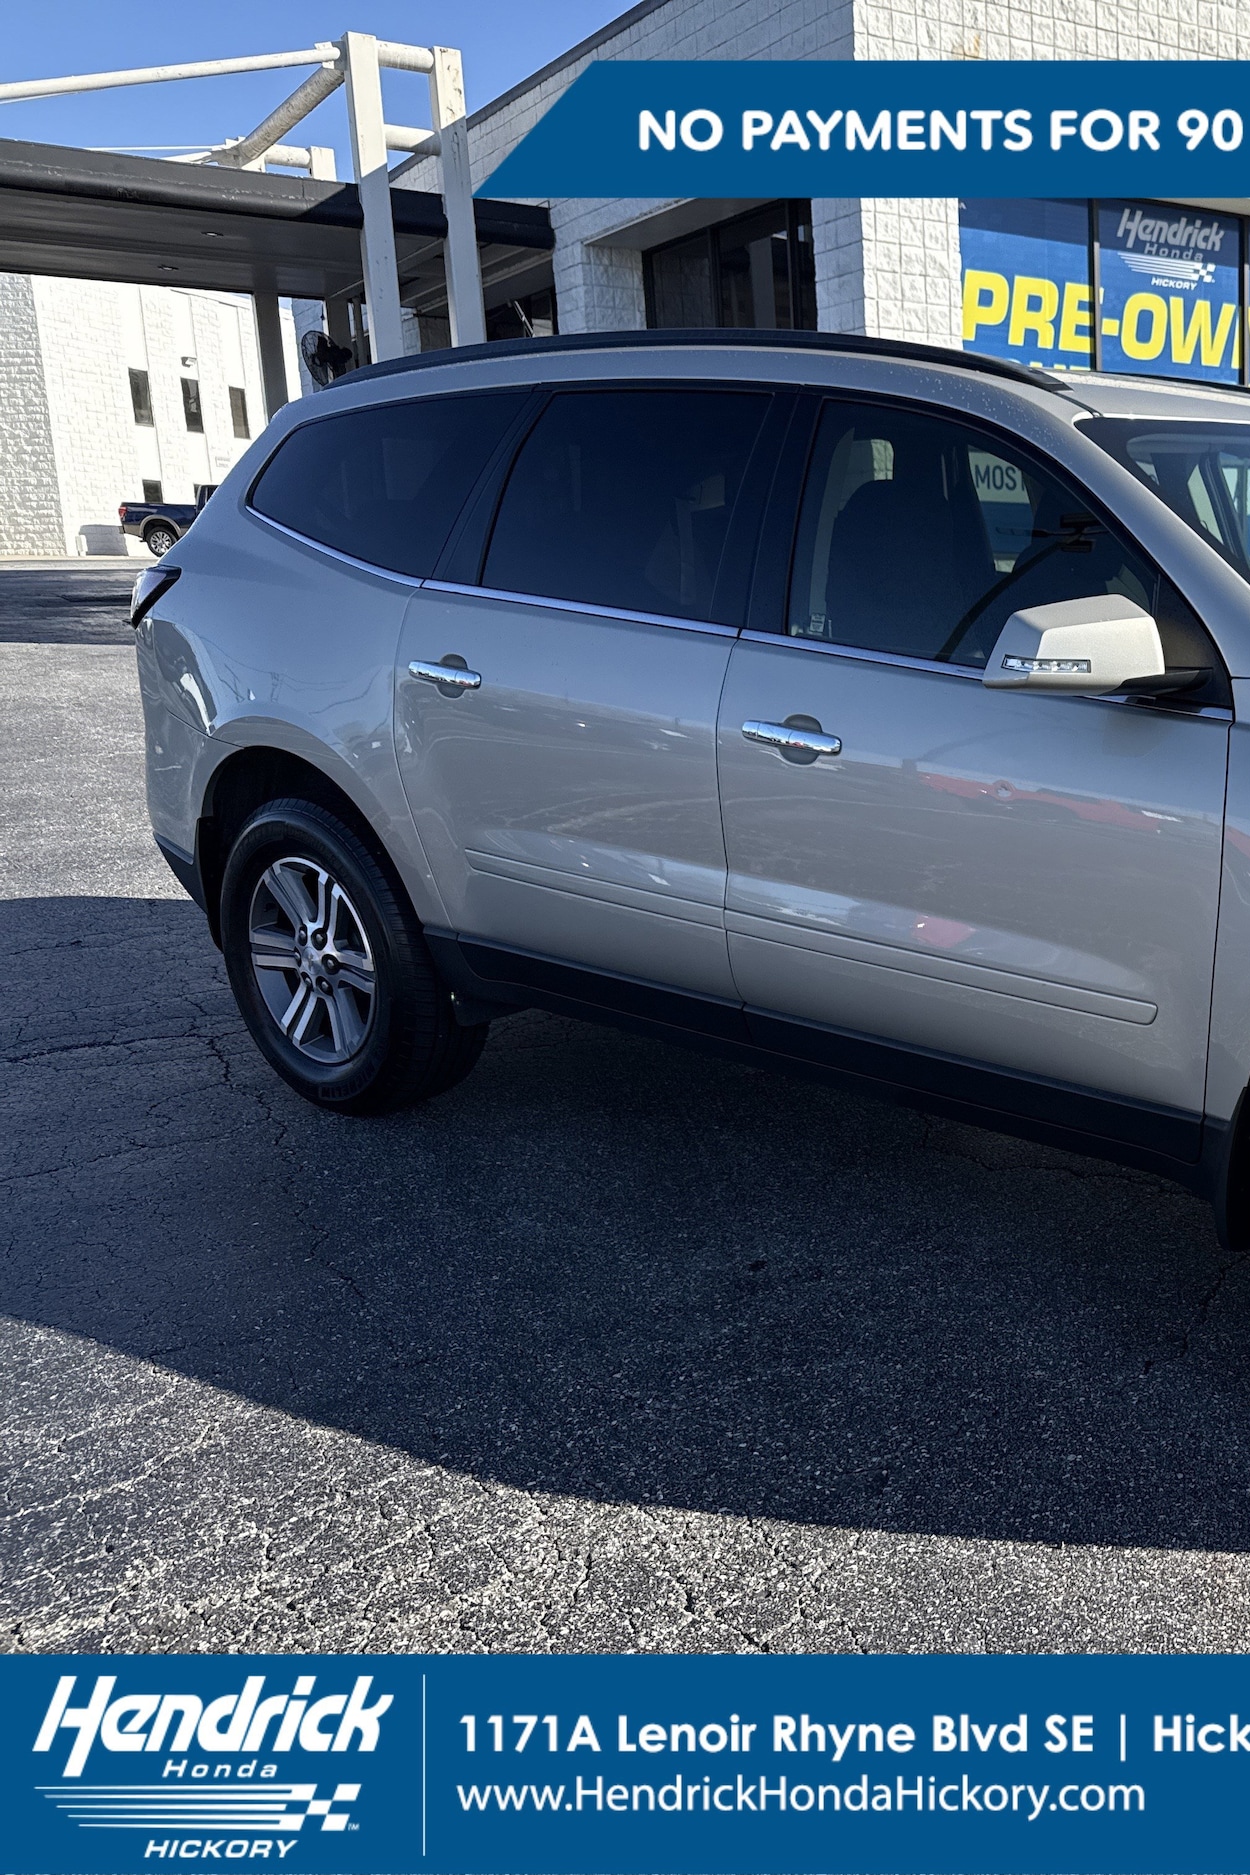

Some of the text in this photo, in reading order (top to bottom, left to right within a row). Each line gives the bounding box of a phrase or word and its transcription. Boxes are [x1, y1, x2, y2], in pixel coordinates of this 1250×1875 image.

[1116, 208, 1225, 252] Hendrick
[1143, 242, 1204, 261] Honda
[1150, 277, 1198, 291] HICKORY
